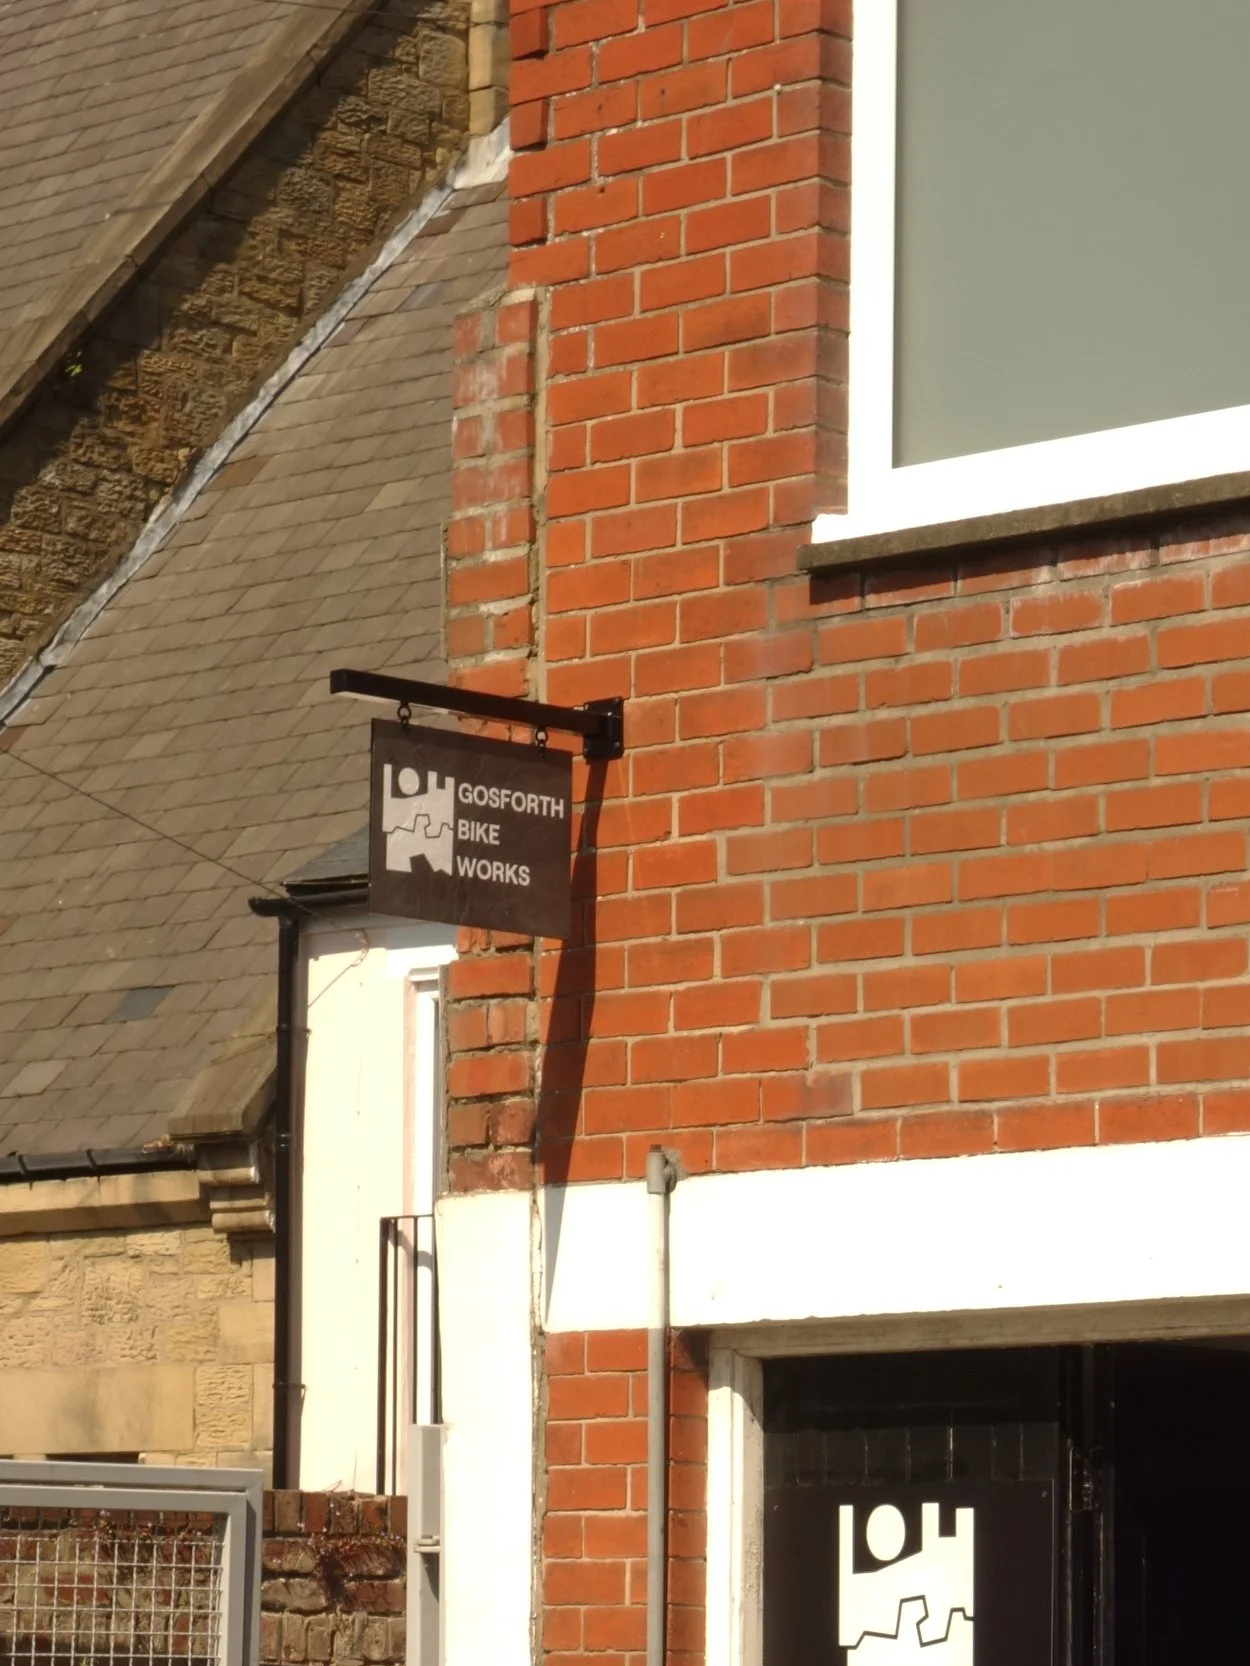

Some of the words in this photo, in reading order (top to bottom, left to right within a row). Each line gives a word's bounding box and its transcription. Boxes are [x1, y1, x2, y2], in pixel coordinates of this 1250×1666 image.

[458, 783, 564, 819] GOSFORTH
[457, 819, 500, 845] BIKE
[457, 855, 530, 886] WORKS
